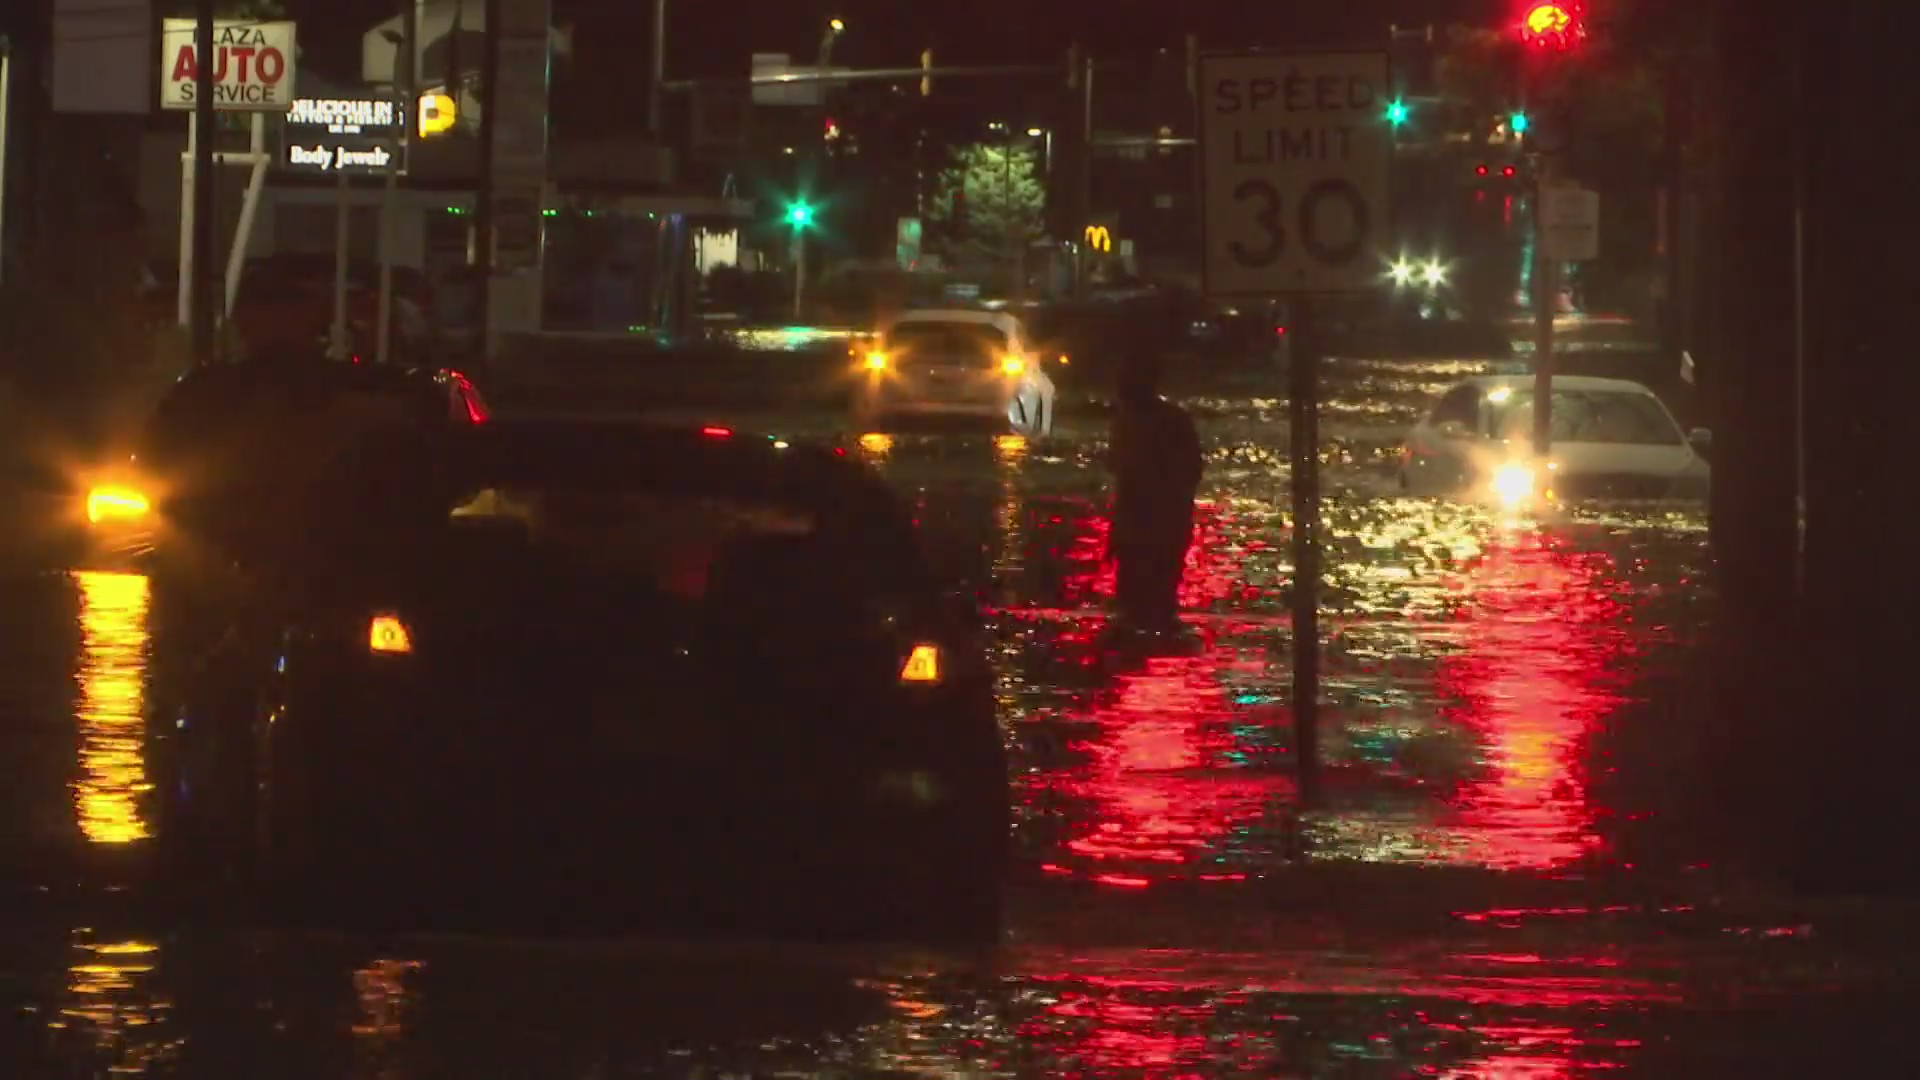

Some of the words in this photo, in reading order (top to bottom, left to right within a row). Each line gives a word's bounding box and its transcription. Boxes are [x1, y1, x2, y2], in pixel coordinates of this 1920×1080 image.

[193, 27, 266, 46] AZA
[172, 45, 285, 84] AUTO
[180, 83, 276, 103] SRVICE
[1216, 75, 1374, 113] SPEED
[290, 145, 333, 171] Body
[335, 146, 391, 170] Jewelr
[1233, 127, 1356, 164] LIMIT
[1227, 178, 1369, 268] 30
